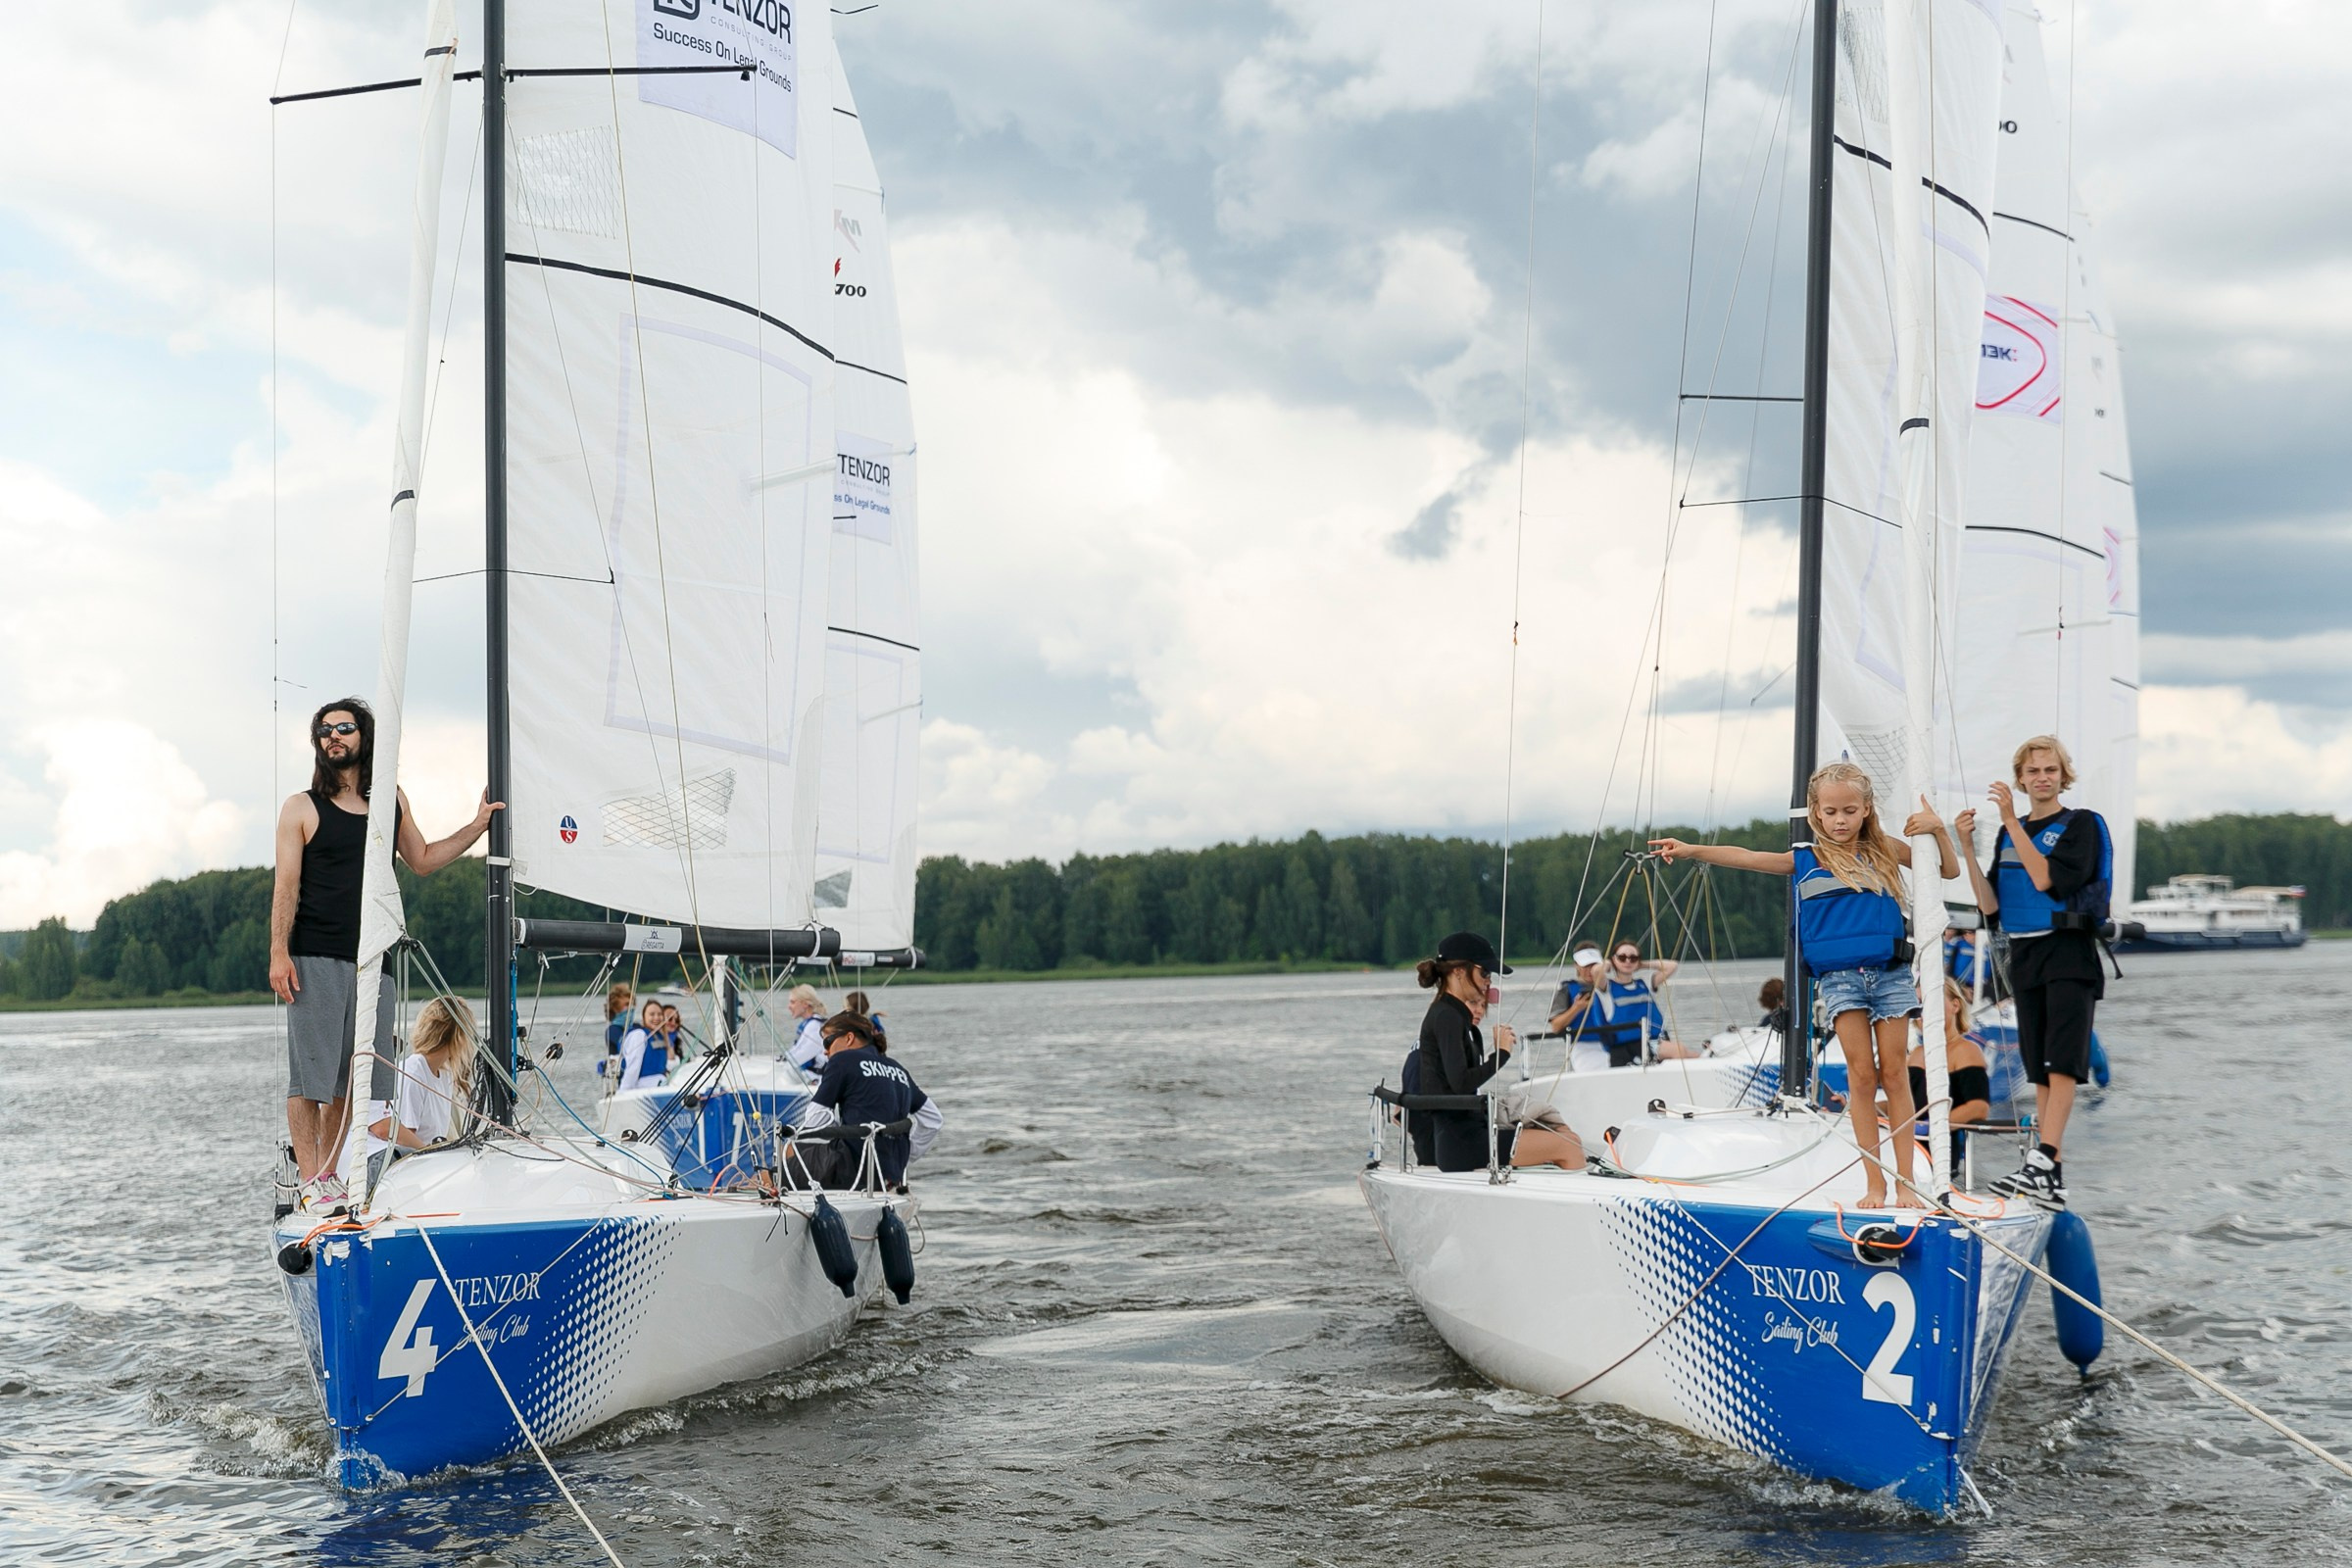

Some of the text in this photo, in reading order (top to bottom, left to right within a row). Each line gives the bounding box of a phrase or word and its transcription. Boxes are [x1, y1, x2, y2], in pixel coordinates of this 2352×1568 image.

[710, 0, 792, 45] NZOR
[710, 16, 792, 61] CONSULTING GROUP
[653, 22, 712, 54] Success
[715, 40, 731, 61] On
[759, 60, 792, 93] Grounds
[834, 283, 867, 298] 700
[837, 453, 891, 487] TENZOR
[844, 494, 854, 504] On
[377, 1272, 541, 1398] 4 TENZOR
[500, 1314, 531, 1344] Club
[1746, 1264, 1917, 1407] TENZOR 2
[1761, 1310, 1838, 1354] Sailing Club
